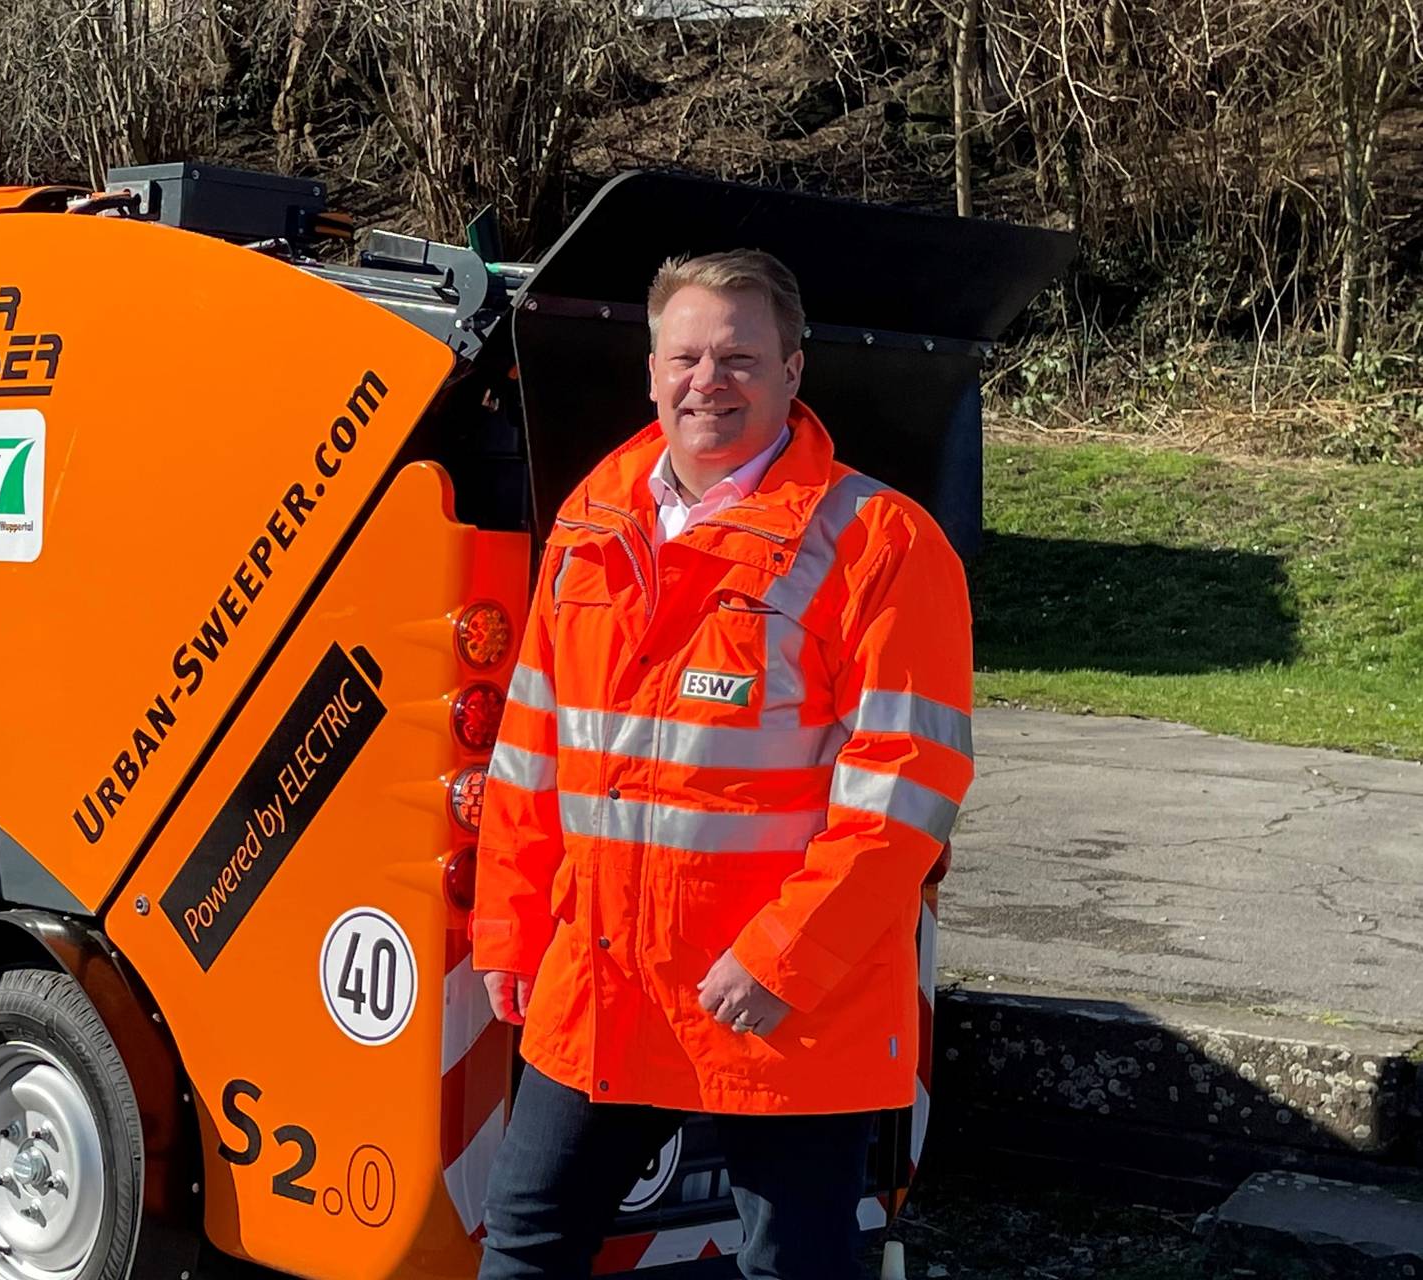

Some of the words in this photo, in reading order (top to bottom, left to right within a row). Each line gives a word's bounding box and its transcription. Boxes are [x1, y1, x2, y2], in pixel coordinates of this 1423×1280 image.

[72, 369, 389, 844] URBAN-SWEEPER.com
[686, 674, 735, 697] ESW
[184, 820, 263, 944] Powered
[254, 794, 286, 838] by
[277, 678, 363, 805] ELECTRIC
[337, 931, 397, 1021] 40
